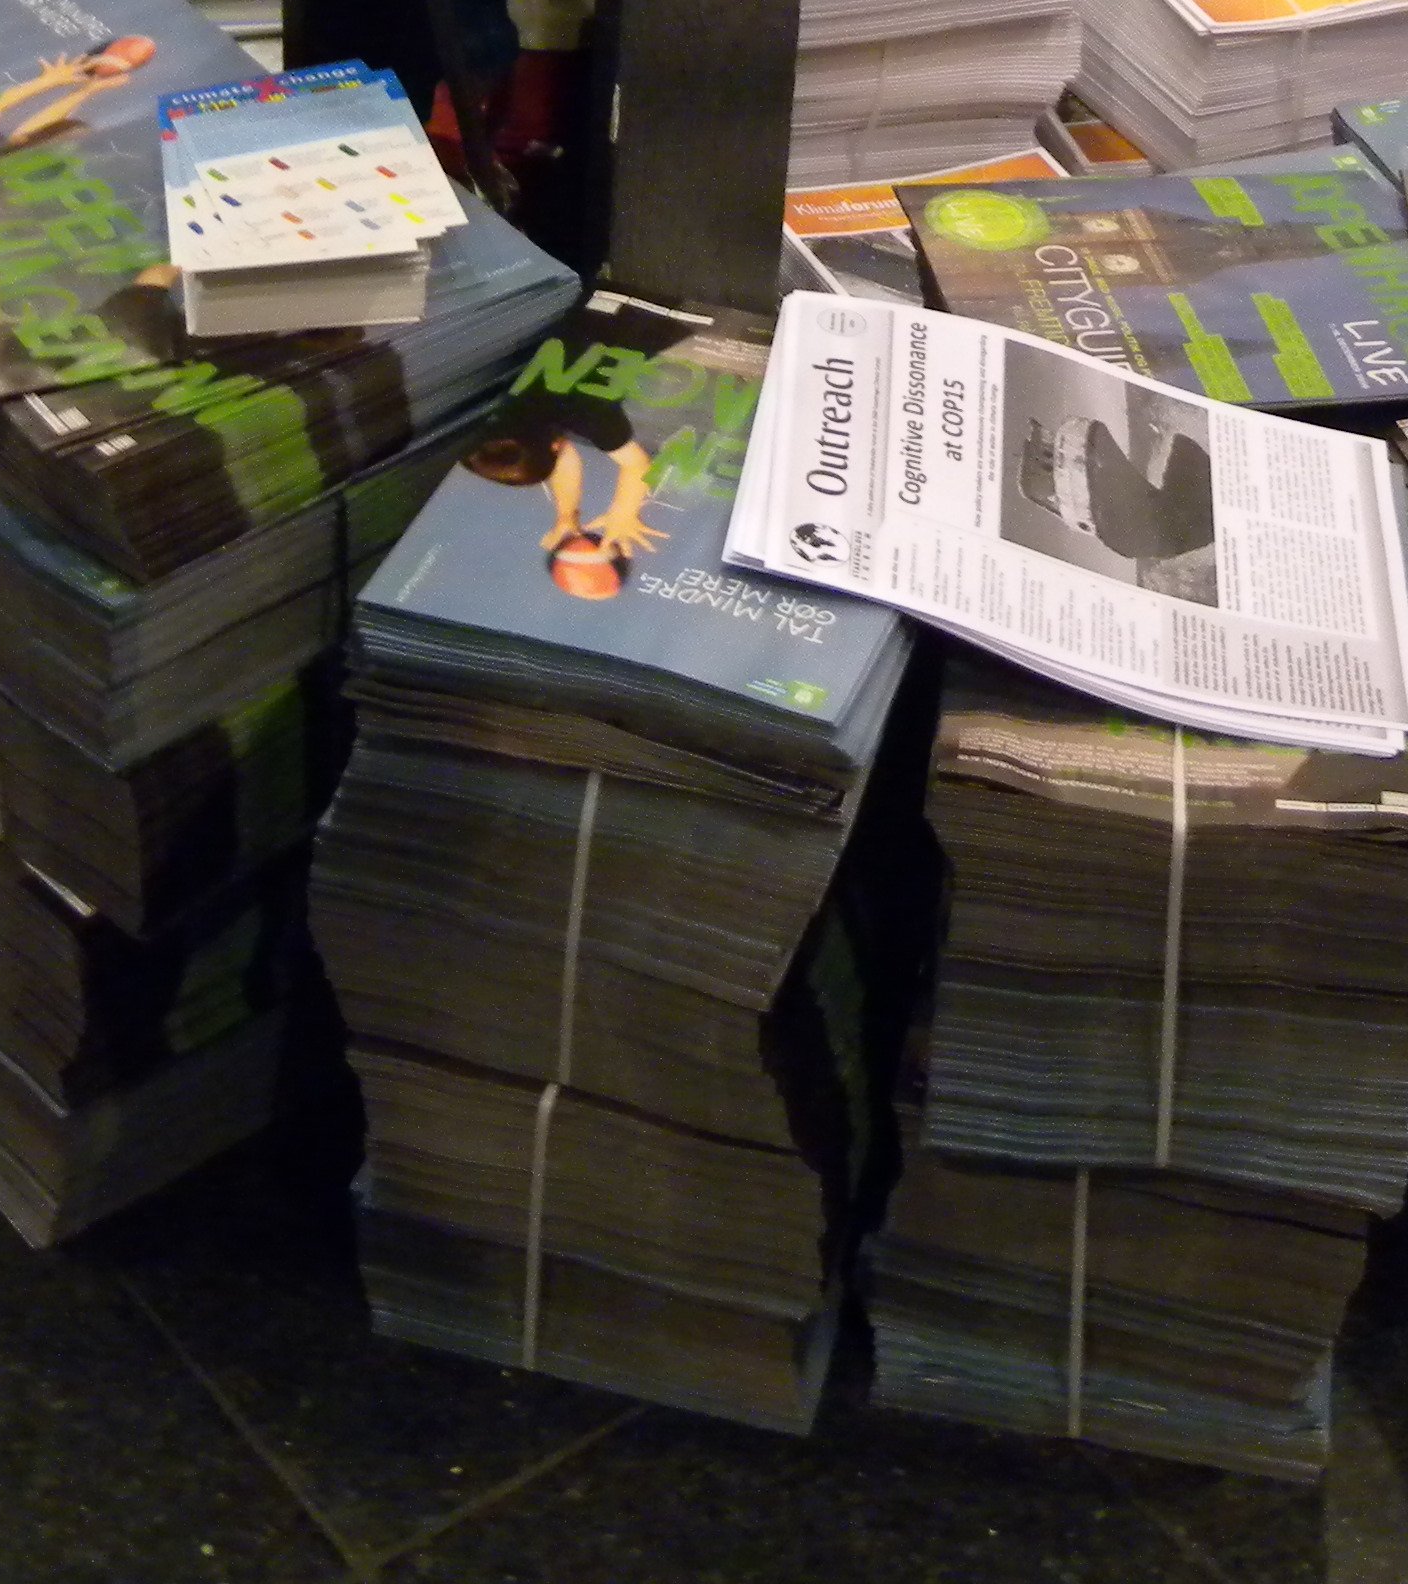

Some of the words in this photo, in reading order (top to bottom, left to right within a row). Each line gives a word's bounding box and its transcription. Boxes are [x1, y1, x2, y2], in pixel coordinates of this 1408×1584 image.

[1117, 318, 1141, 354] POLITIK
[902, 322, 927, 414] Dissonance
[806, 358, 853, 495] Outreach
[940, 378, 963, 436] COP15
[898, 420, 927, 504] Cognitive
[942, 439, 963, 461] at
[636, 570, 763, 621] MINDRE,
[684, 566, 771, 610] MERE!
[771, 593, 837, 628] GØR
[769, 610, 826, 645] TAL
